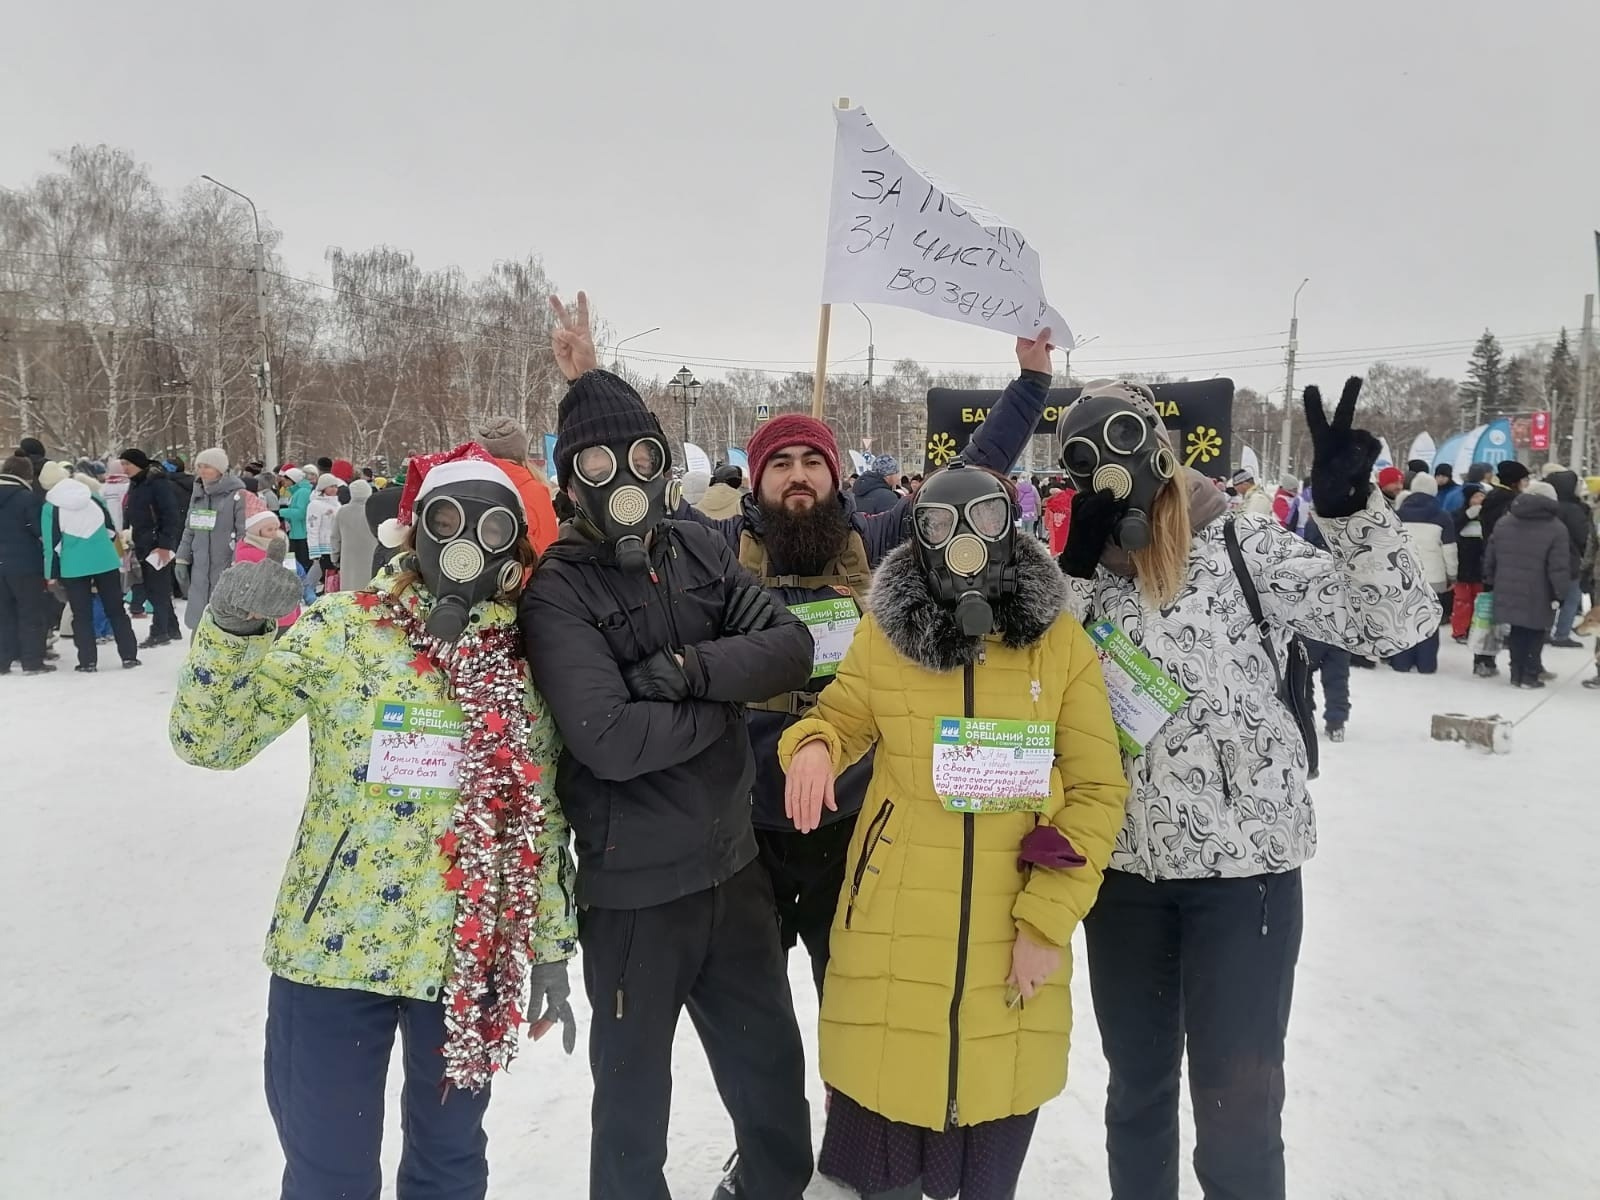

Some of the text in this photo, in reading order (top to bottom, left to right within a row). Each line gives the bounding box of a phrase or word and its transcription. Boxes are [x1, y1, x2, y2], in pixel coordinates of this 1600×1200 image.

[851, 170, 903, 208] ЗА
[846, 215, 895, 254] ЗА
[790, 606, 811, 615] АБЕГ
[1113, 633, 1138, 657] ЗАБЕГ
[1147, 684, 1175, 708] 2023
[1156, 676, 1182, 700] 01.01
[410, 707, 446, 718] ЗАБЕГ
[409, 716, 464, 730] ОБЕЩАНИ
[965, 721, 1051, 735] ЗАБЕГ 01.01
[965, 731, 1024, 743] ОБЕЩАНИЙ
[1025, 736, 1051, 747] 2023
